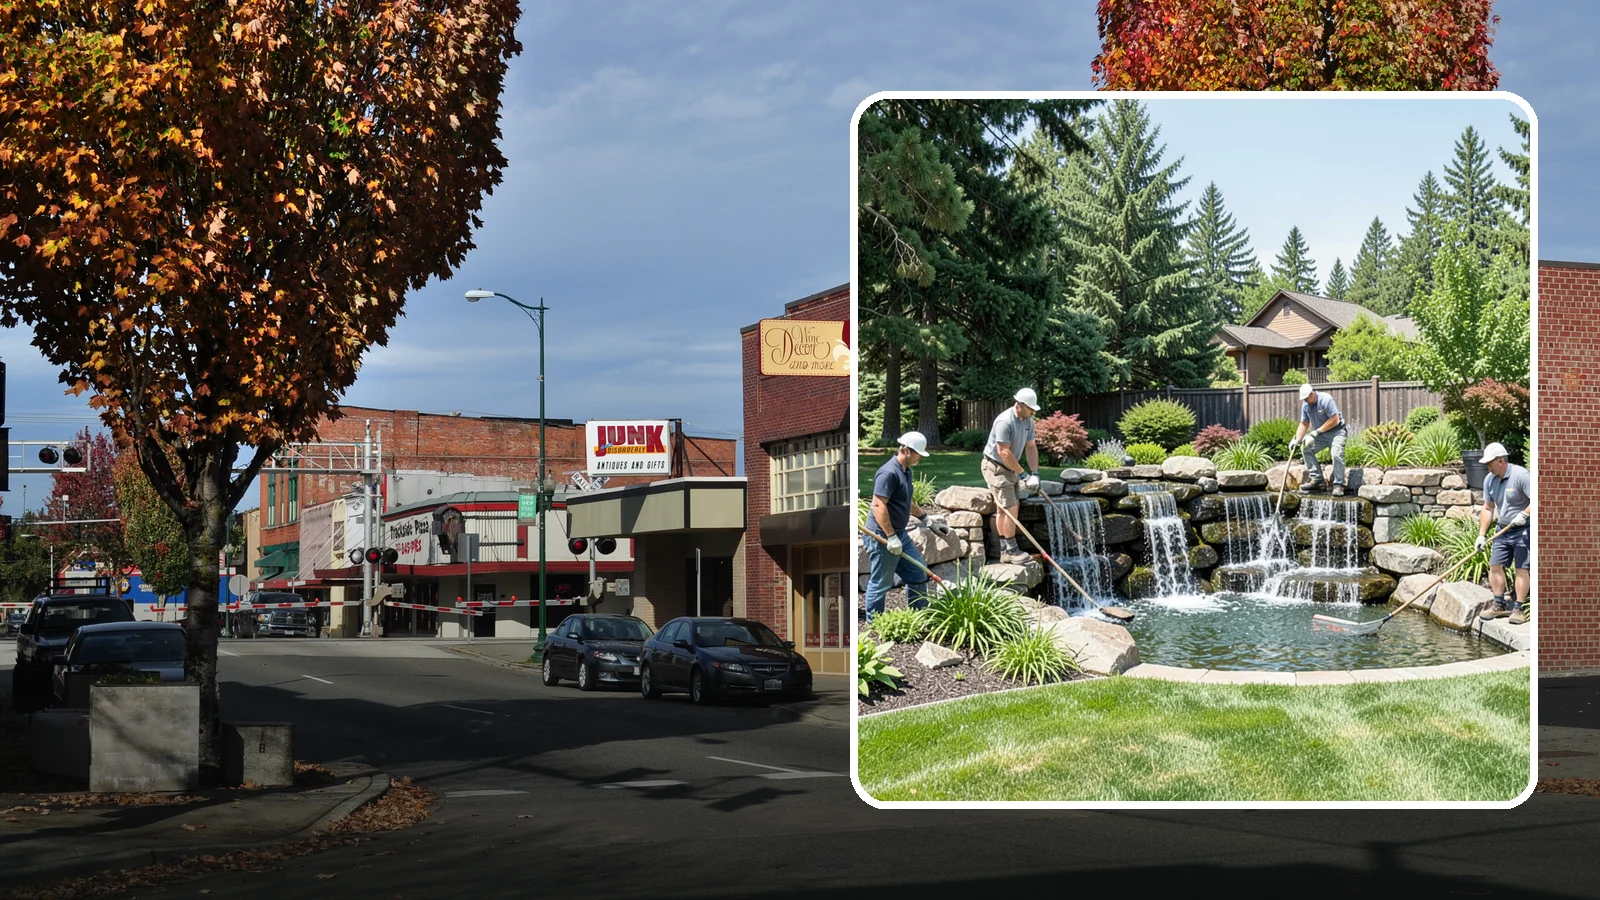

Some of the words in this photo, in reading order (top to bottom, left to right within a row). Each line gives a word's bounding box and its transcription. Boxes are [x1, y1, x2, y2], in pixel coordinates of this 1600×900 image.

[595, 425, 666, 457] JUNK
[607, 446, 646, 454] DISORDERLY
[597, 461, 628, 470] ANTIQUES
[631, 461, 644, 469] AND
[646, 460, 665, 469] GIFTS
[390, 521, 413, 540] Trackside
[414, 519, 429, 535] Pizza
